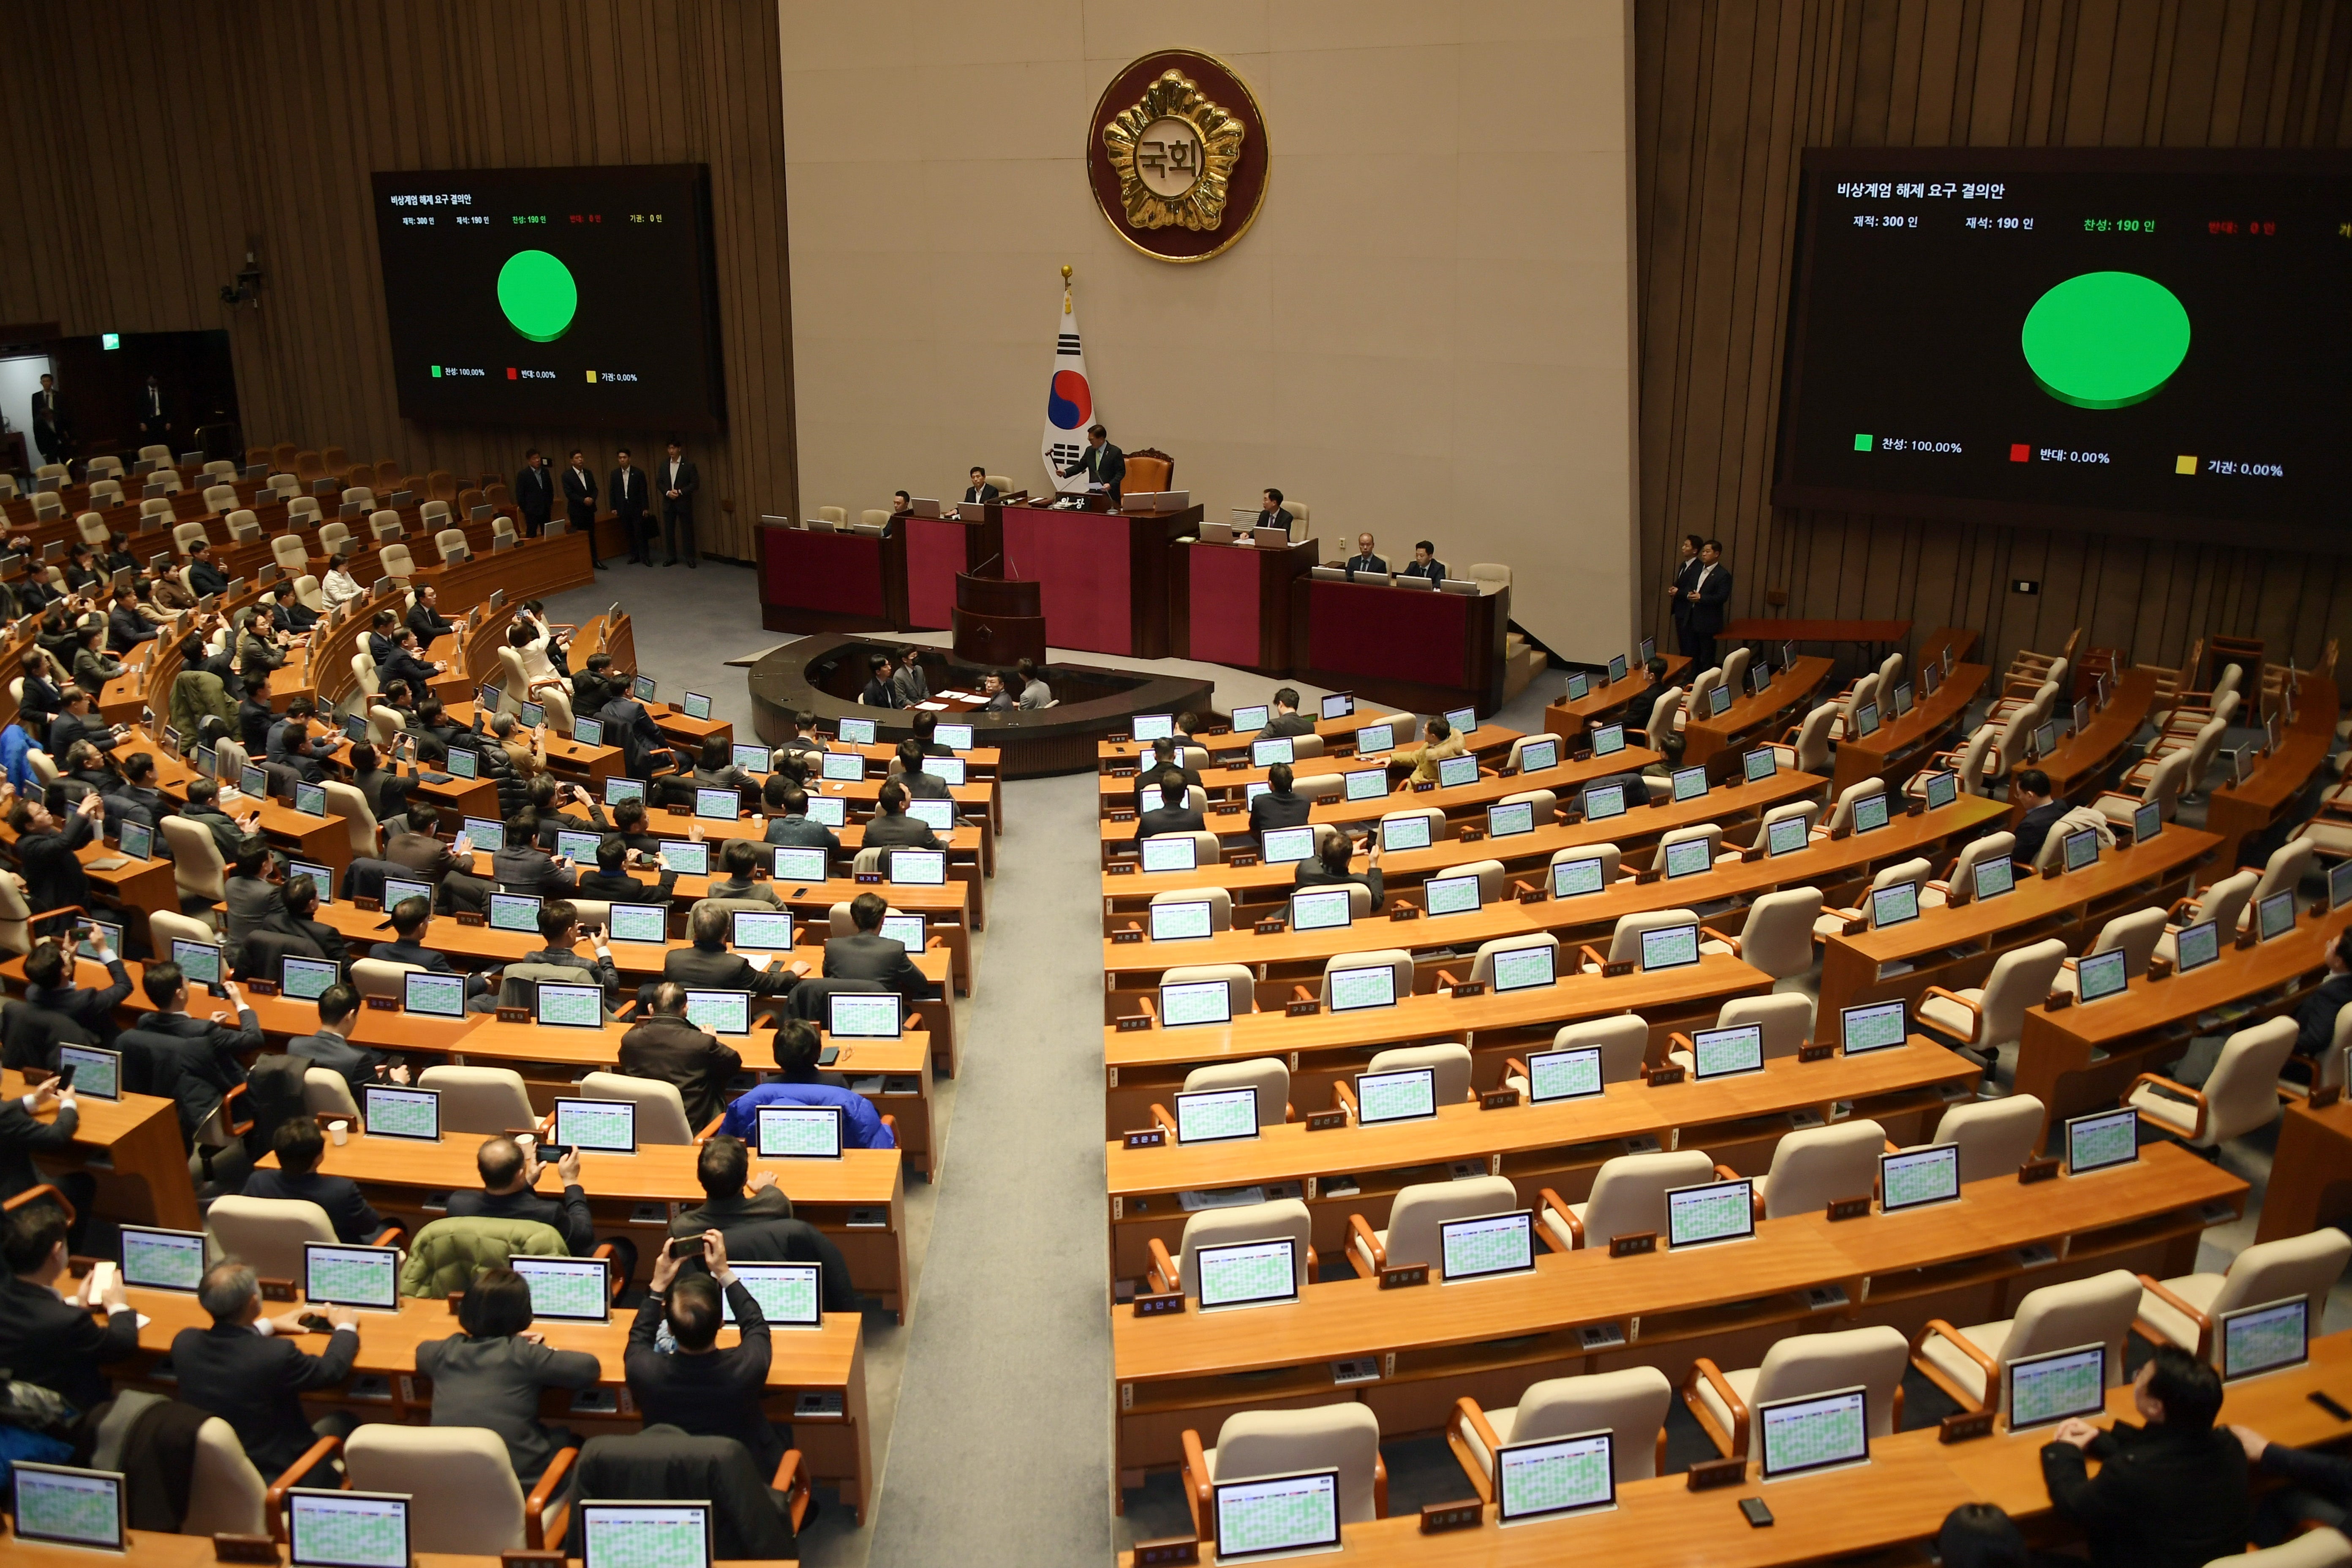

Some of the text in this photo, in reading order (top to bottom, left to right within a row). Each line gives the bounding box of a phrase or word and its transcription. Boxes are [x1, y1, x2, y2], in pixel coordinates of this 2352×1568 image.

[1139, 139, 1196, 178] 국회
[1838, 182, 2005, 199] 비상계엄 해제 요구 결의안
[390, 193, 472, 206] 비상계엄 해제 요구 결의안
[403, 217, 435, 226] 재적: 300 인
[456, 217, 470, 225] 재석:
[483, 216, 490, 224] 인
[630, 214, 662, 223] 기권: 0 인
[1853, 215, 1918, 228] 재적: 300 인
[1965, 217, 2034, 230] 재석: 190 인
[2084, 219, 2155, 232] 찬성: 190 인
[445, 368, 458, 376] 찬성:
[521, 370, 535, 378] 반대:
[602, 373, 637, 382] 기권: 0.00%
[1882, 438, 1962, 454] 찬성: 100.00%
[2040, 449, 2110, 464] 반대: 0.00%
[2208, 460, 2283, 477] 기권: 0.00%
